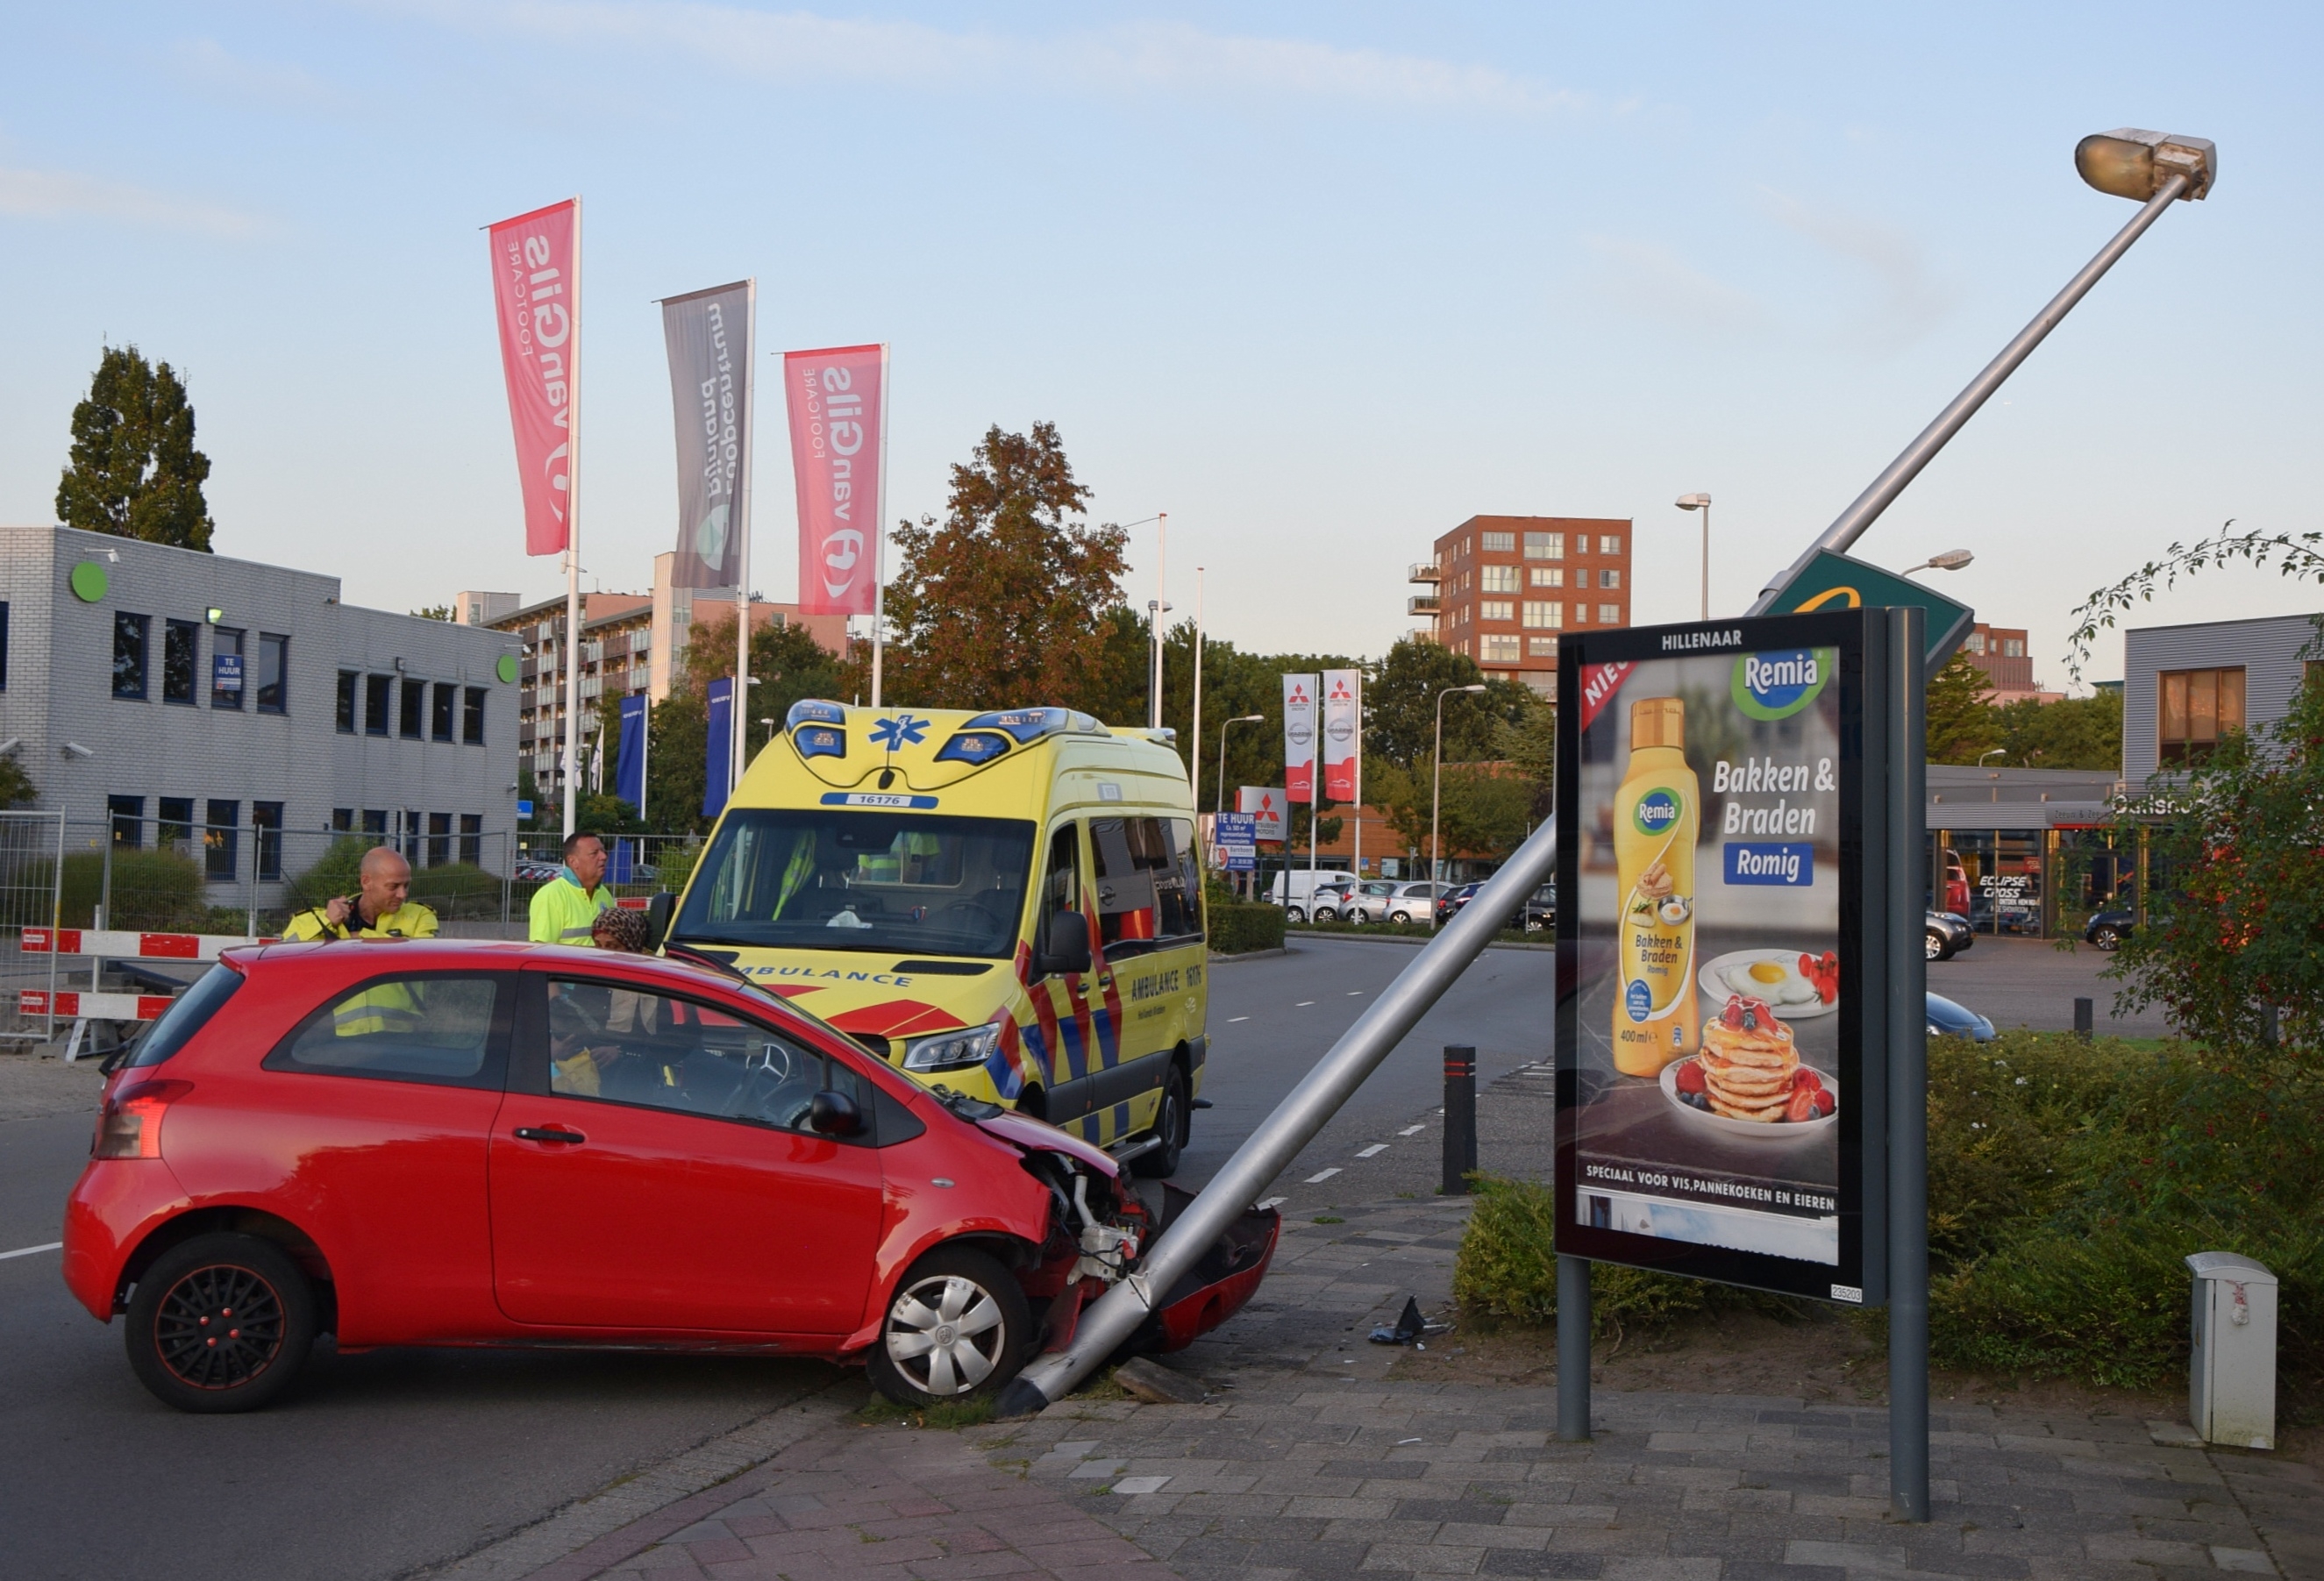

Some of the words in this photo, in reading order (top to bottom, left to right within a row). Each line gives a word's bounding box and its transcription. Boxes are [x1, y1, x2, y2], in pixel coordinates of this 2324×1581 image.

[1662, 630, 1743, 651] HILLENAAR
[225, 658, 235, 666] TE
[218, 666, 241, 675] HUUR
[1744, 654, 1818, 694] Remia
[1713, 757, 1807, 793] Bakken
[1814, 757, 1836, 791] &
[860, 795, 901, 805] 16176
[1217, 813, 1228, 823] TE
[1230, 814, 1255, 824] HUUR
[1638, 802, 1676, 823] Remia
[1723, 799, 1815, 834] Braden
[1736, 847, 1800, 883] Romig
[1979, 875, 2027, 887] ECLIPSE
[1983, 887, 2021, 898] CROSS
[1636, 933, 1672, 949] Bakken
[1675, 936, 1683, 949] &
[1642, 949, 1678, 964] Braden
[735, 966, 913, 987] MBULANCE
[1647, 965, 1669, 976] Romig
[1131, 969, 1180, 1001] AMBULANCE
[1620, 1029, 1636, 1043] 400
[1636, 1030, 1648, 1043] ml
[1586, 1164, 1634, 1183] SPECIAAL
[1637, 1171, 1669, 1186] VOOR
[1775, 1190, 1791, 1205] EN
[1794, 1193, 1835, 1210] EIEREN
[1831, 1286, 1861, 1301] 235203
